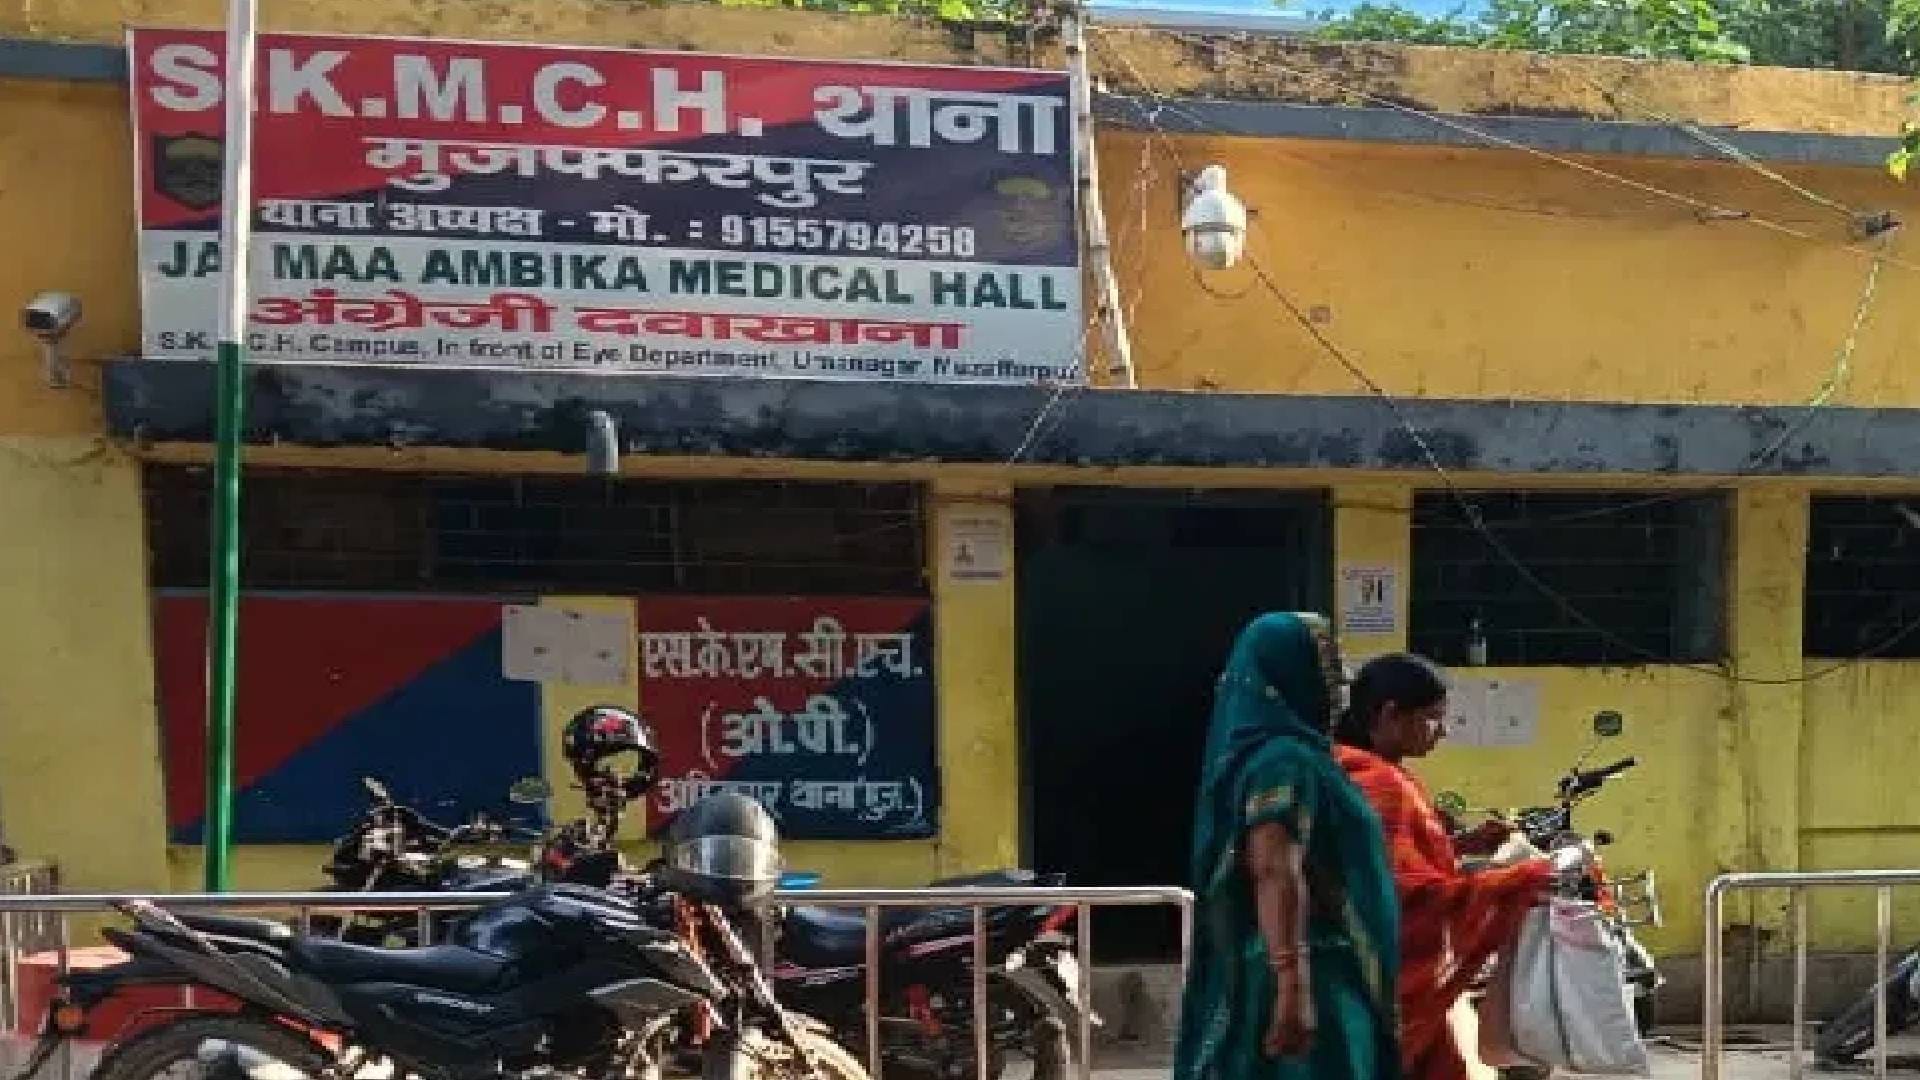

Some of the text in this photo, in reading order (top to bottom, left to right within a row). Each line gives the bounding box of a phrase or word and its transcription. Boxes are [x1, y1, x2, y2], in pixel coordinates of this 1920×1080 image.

[813, 84, 1066, 154] थाना
[361, 136, 876, 208] मुजफ्फरपुर
[158, 240, 1068, 311] JA MAA AMBIKA MEDICAL HALL
[248, 287, 971, 351] अंग्रेजी दवाखाना
[573, 342, 623, 365] Eye
